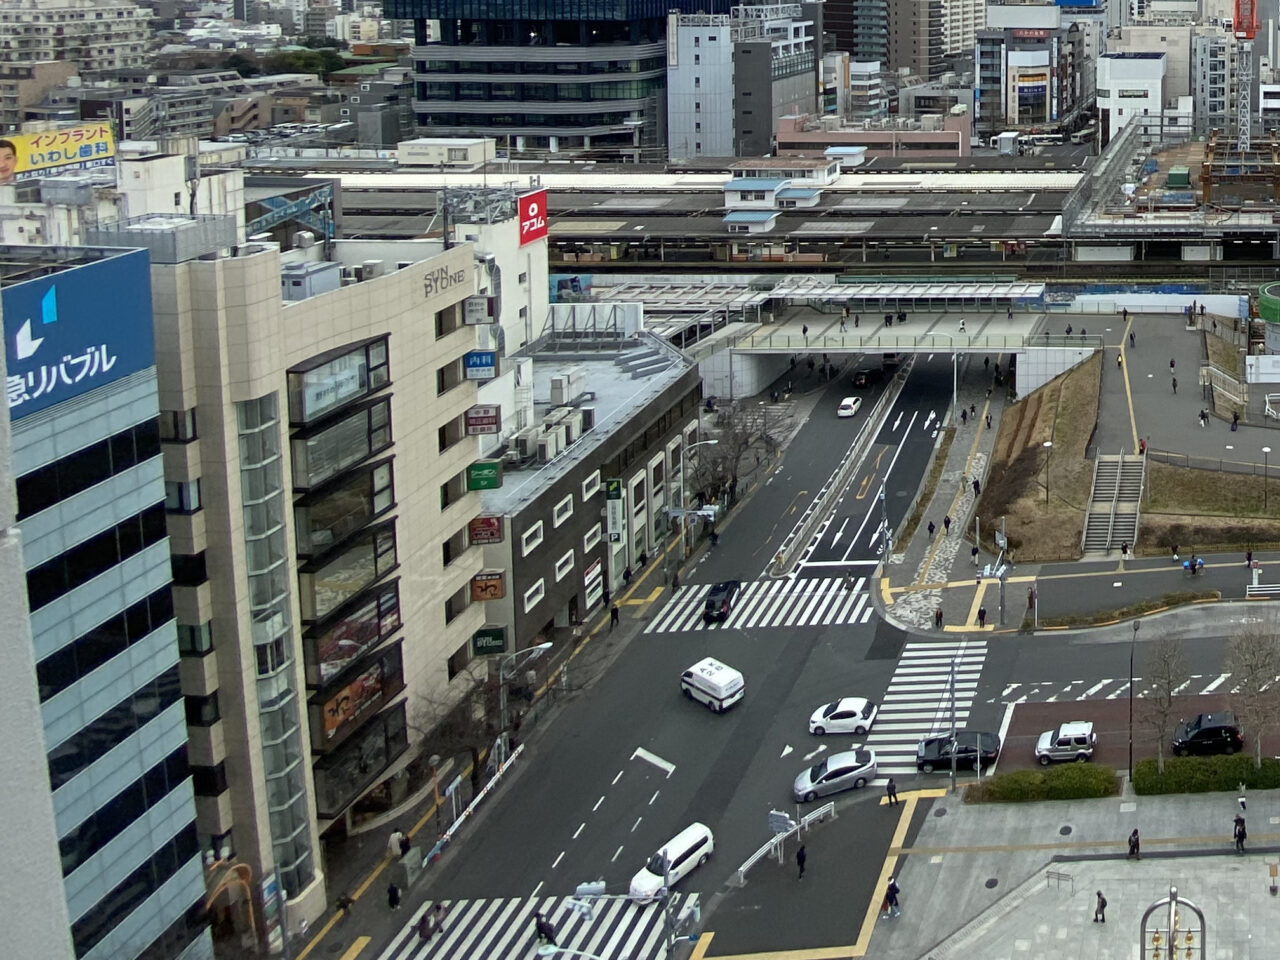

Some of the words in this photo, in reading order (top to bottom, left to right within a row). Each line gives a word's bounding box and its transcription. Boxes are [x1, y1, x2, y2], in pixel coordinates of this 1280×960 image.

[30, 126, 109, 148] インプラント
[30, 142, 109, 165] いわし歯科
[522, 218, 545, 234] アコム
[424, 265, 449, 283] SUN
